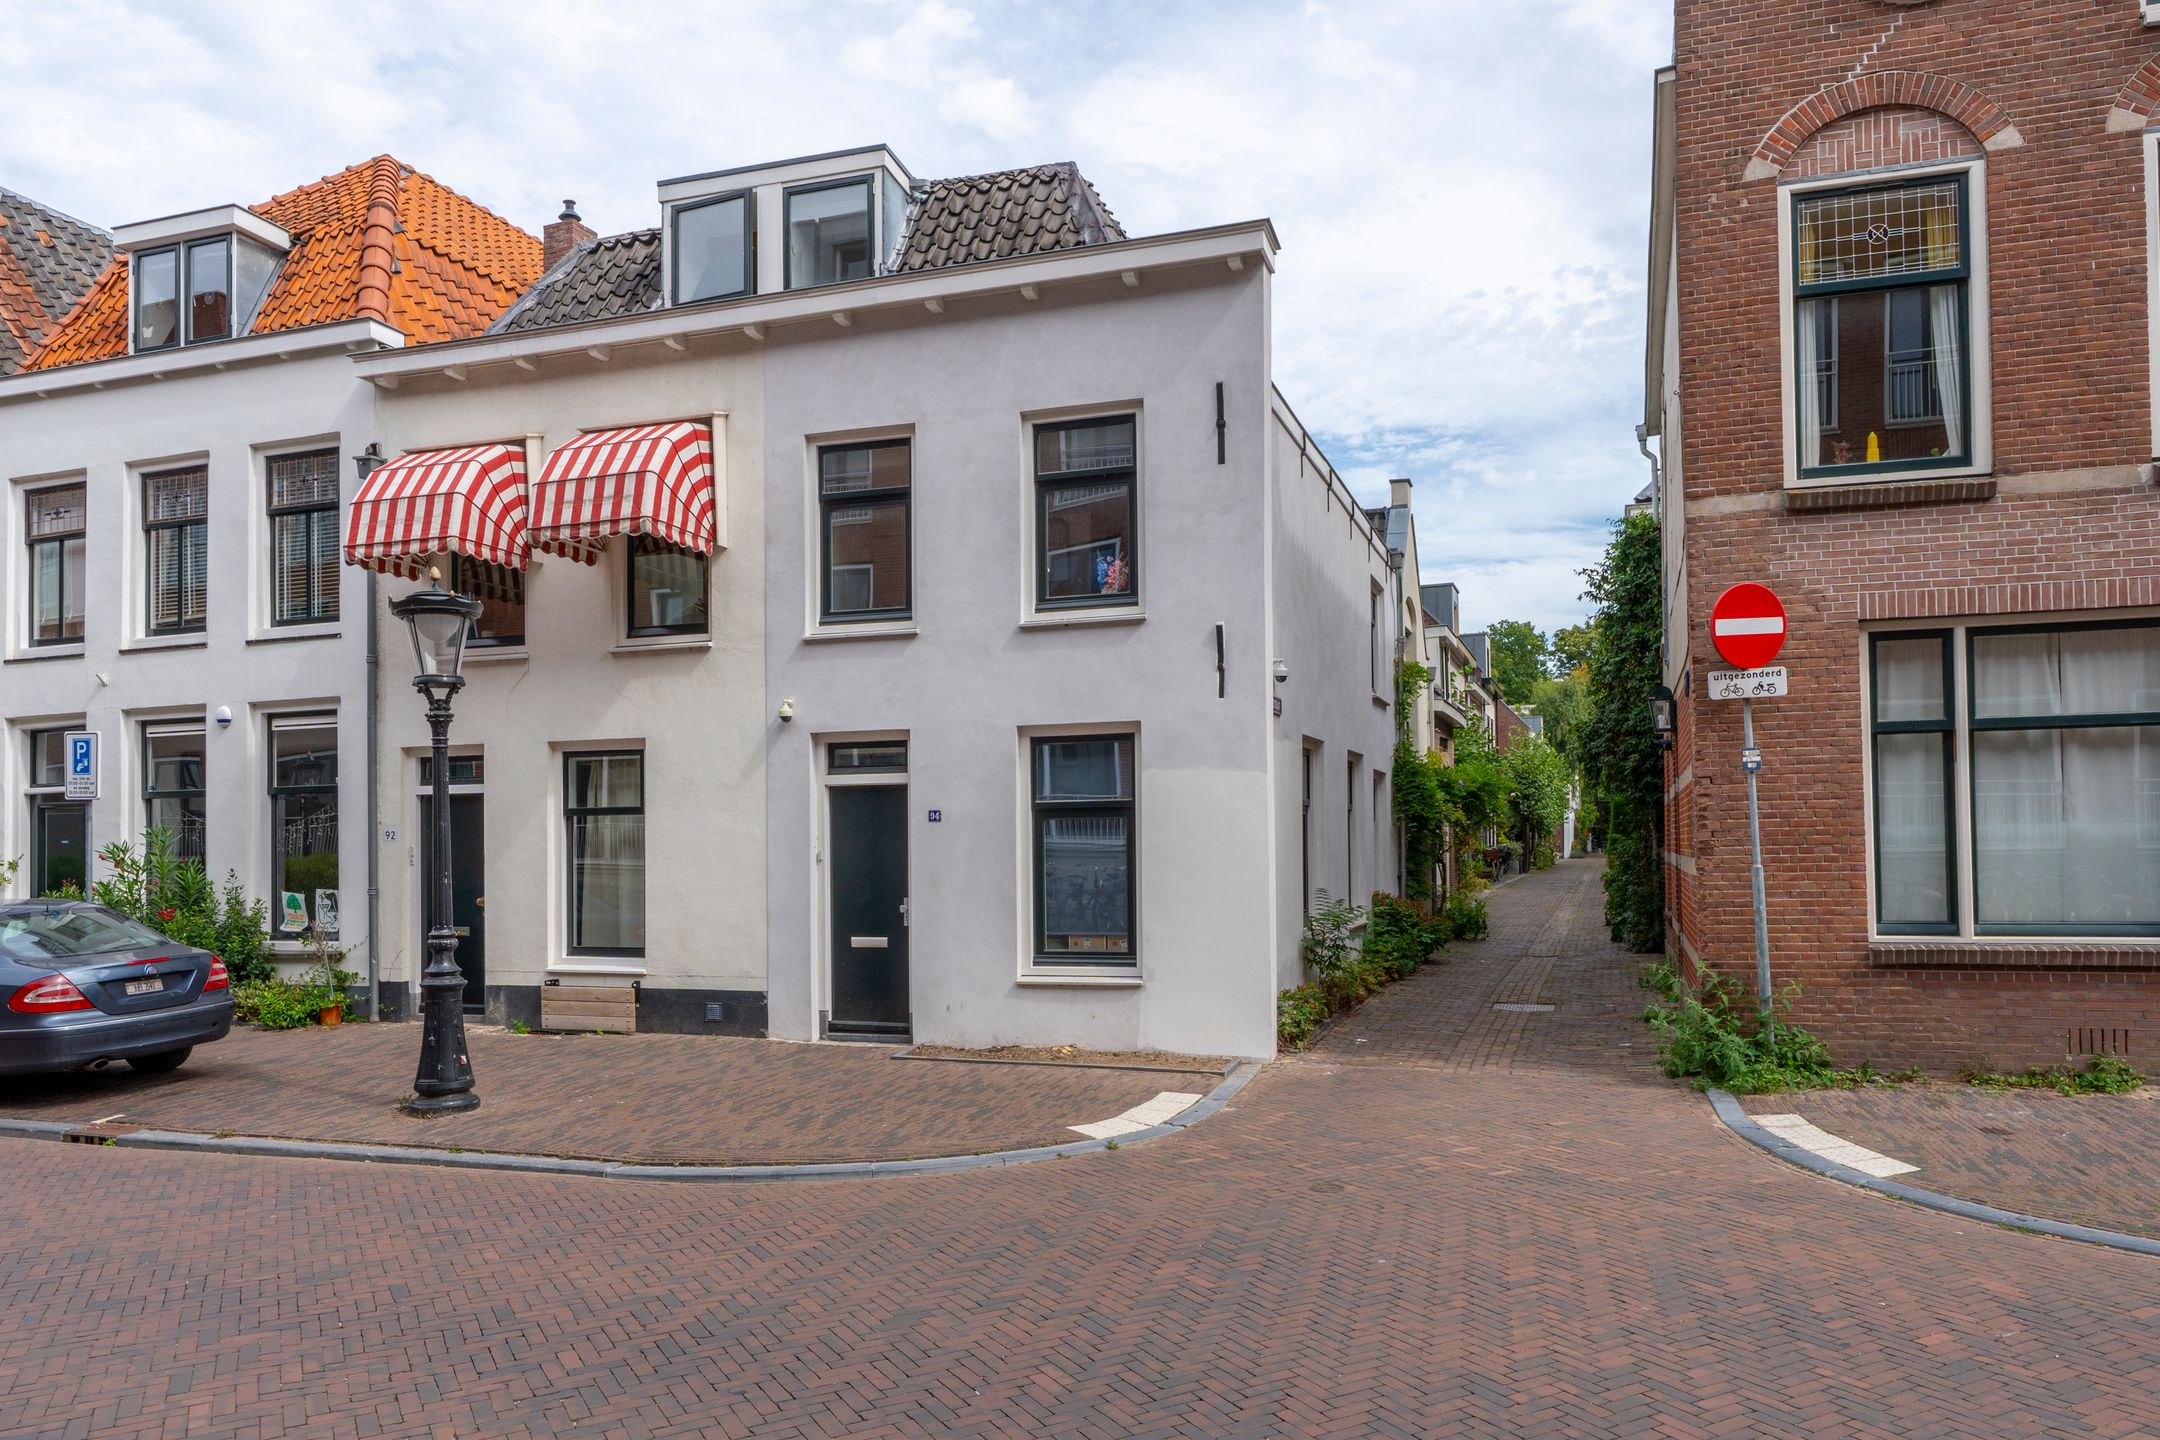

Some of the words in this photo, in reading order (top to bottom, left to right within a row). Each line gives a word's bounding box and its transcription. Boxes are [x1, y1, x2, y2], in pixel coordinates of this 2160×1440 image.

[1713, 669, 1782, 682] uitgezonderd
[76, 742, 86, 760] P
[930, 812, 940, 820] 94
[384, 830, 396, 840] 92
